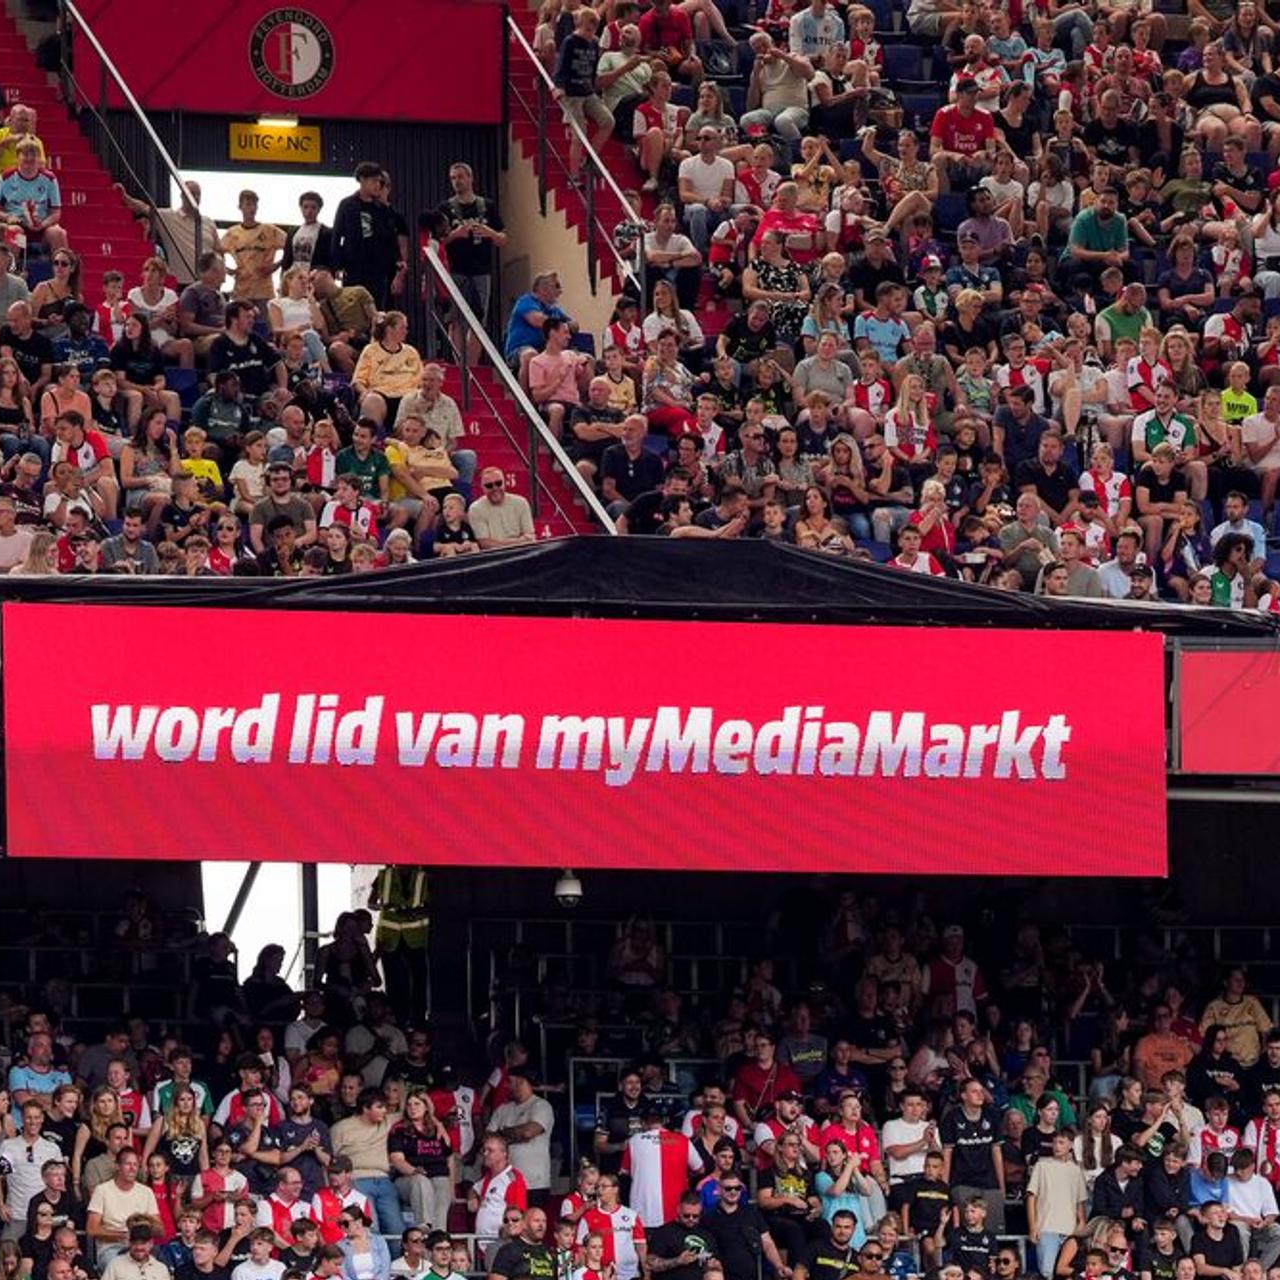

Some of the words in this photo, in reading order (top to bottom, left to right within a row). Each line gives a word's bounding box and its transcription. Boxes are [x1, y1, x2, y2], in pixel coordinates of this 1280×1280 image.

[90, 694, 281, 764] word
[290, 695, 387, 766] lid
[396, 710, 523, 770] van
[536, 705, 1072, 787] myMediaMarkt
